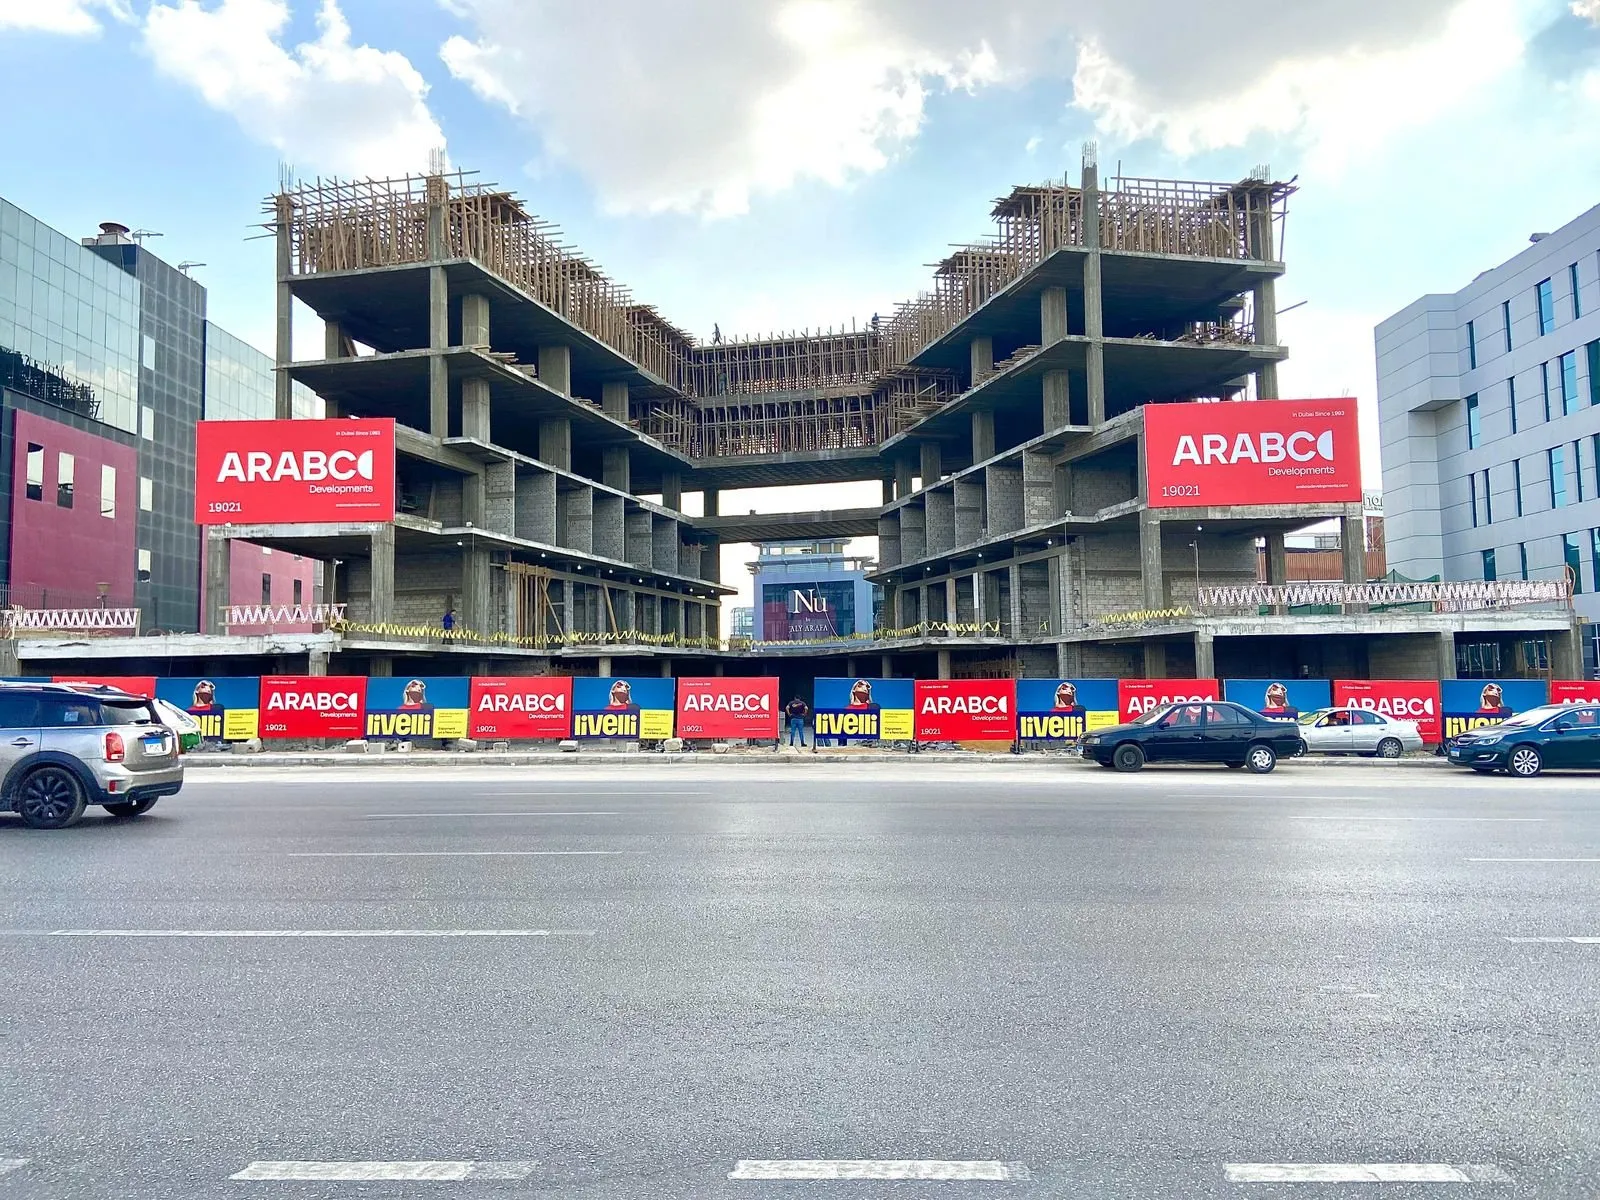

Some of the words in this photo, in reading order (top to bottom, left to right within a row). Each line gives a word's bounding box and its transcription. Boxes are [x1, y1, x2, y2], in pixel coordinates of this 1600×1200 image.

[1268, 466, 1335, 477] Developments
[309, 484, 374, 494] Developments
[1162, 485, 1201, 497] 19021
[208, 502, 242, 513] 19021
[792, 588, 828, 614] Nu
[264, 723, 287, 731] 19021
[366, 713, 431, 736] livelli
[574, 714, 638, 736] livelli
[815, 713, 878, 735] livelli
[1020, 716, 1084, 738] livelli
